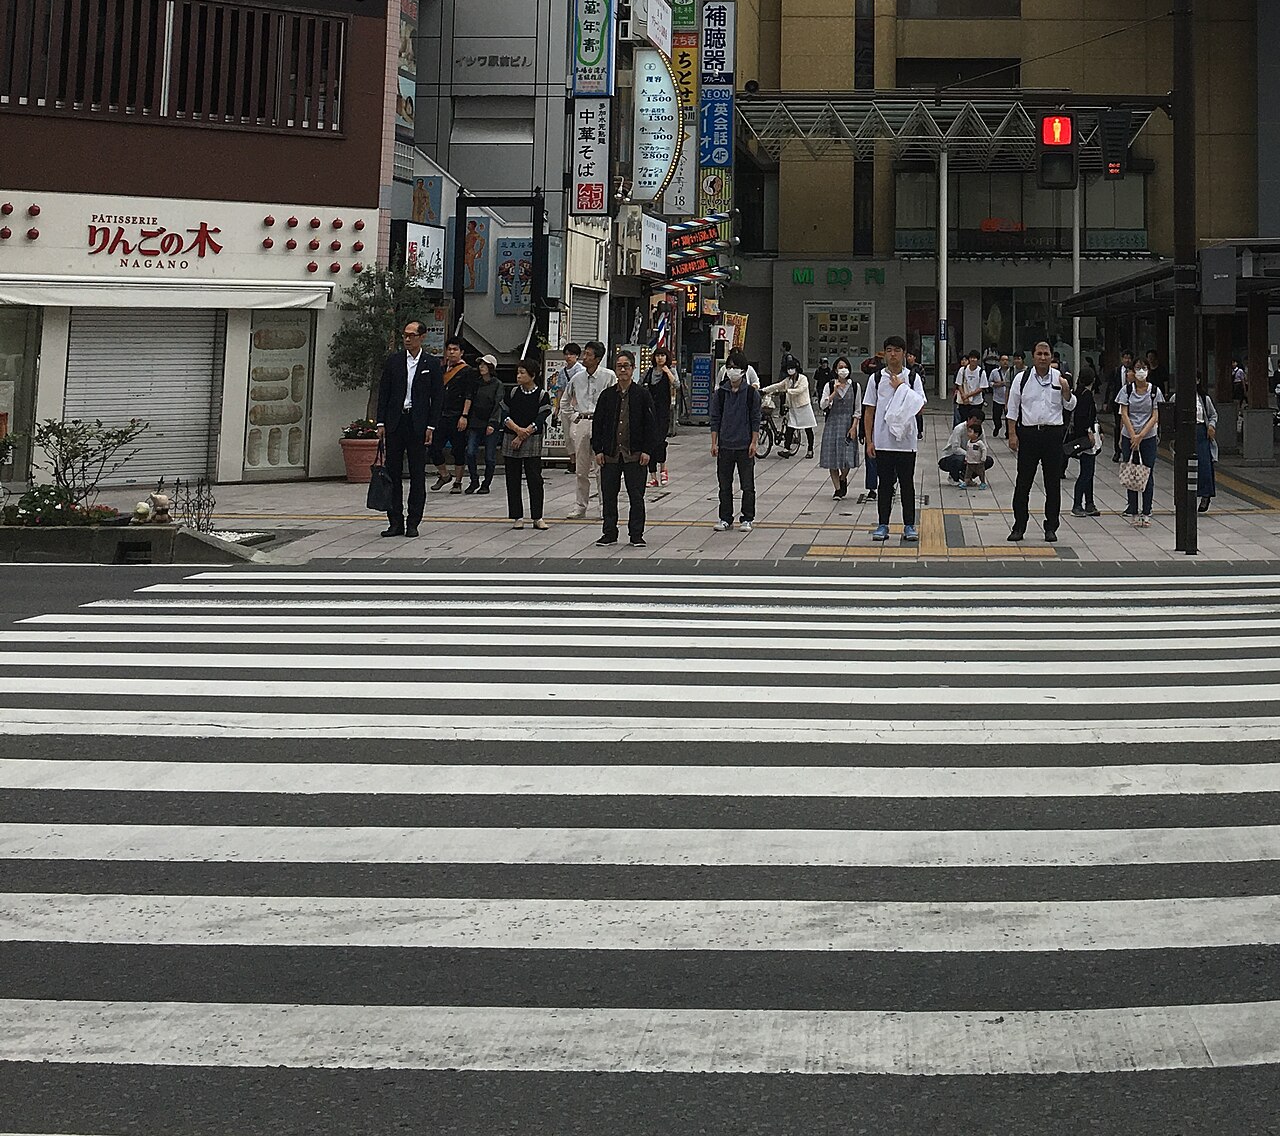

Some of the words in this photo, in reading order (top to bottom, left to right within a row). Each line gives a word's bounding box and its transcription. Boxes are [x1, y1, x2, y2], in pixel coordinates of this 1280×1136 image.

[704, 5, 727, 71] 補聴器
[702, 90, 730, 99] AEON
[700, 102, 712, 164] イーオン
[714, 102, 728, 146] 英会話
[578, 108, 596, 178] 中華そば
[714, 151, 727, 162] 4F
[674, 195, 685, 206] 18
[88, 222, 223, 258] りんごの木
[120, 259, 189, 269] NAGANO
[792, 268, 814, 285] MI
[827, 268, 852, 285] DO
[865, 268, 886, 285] RI
